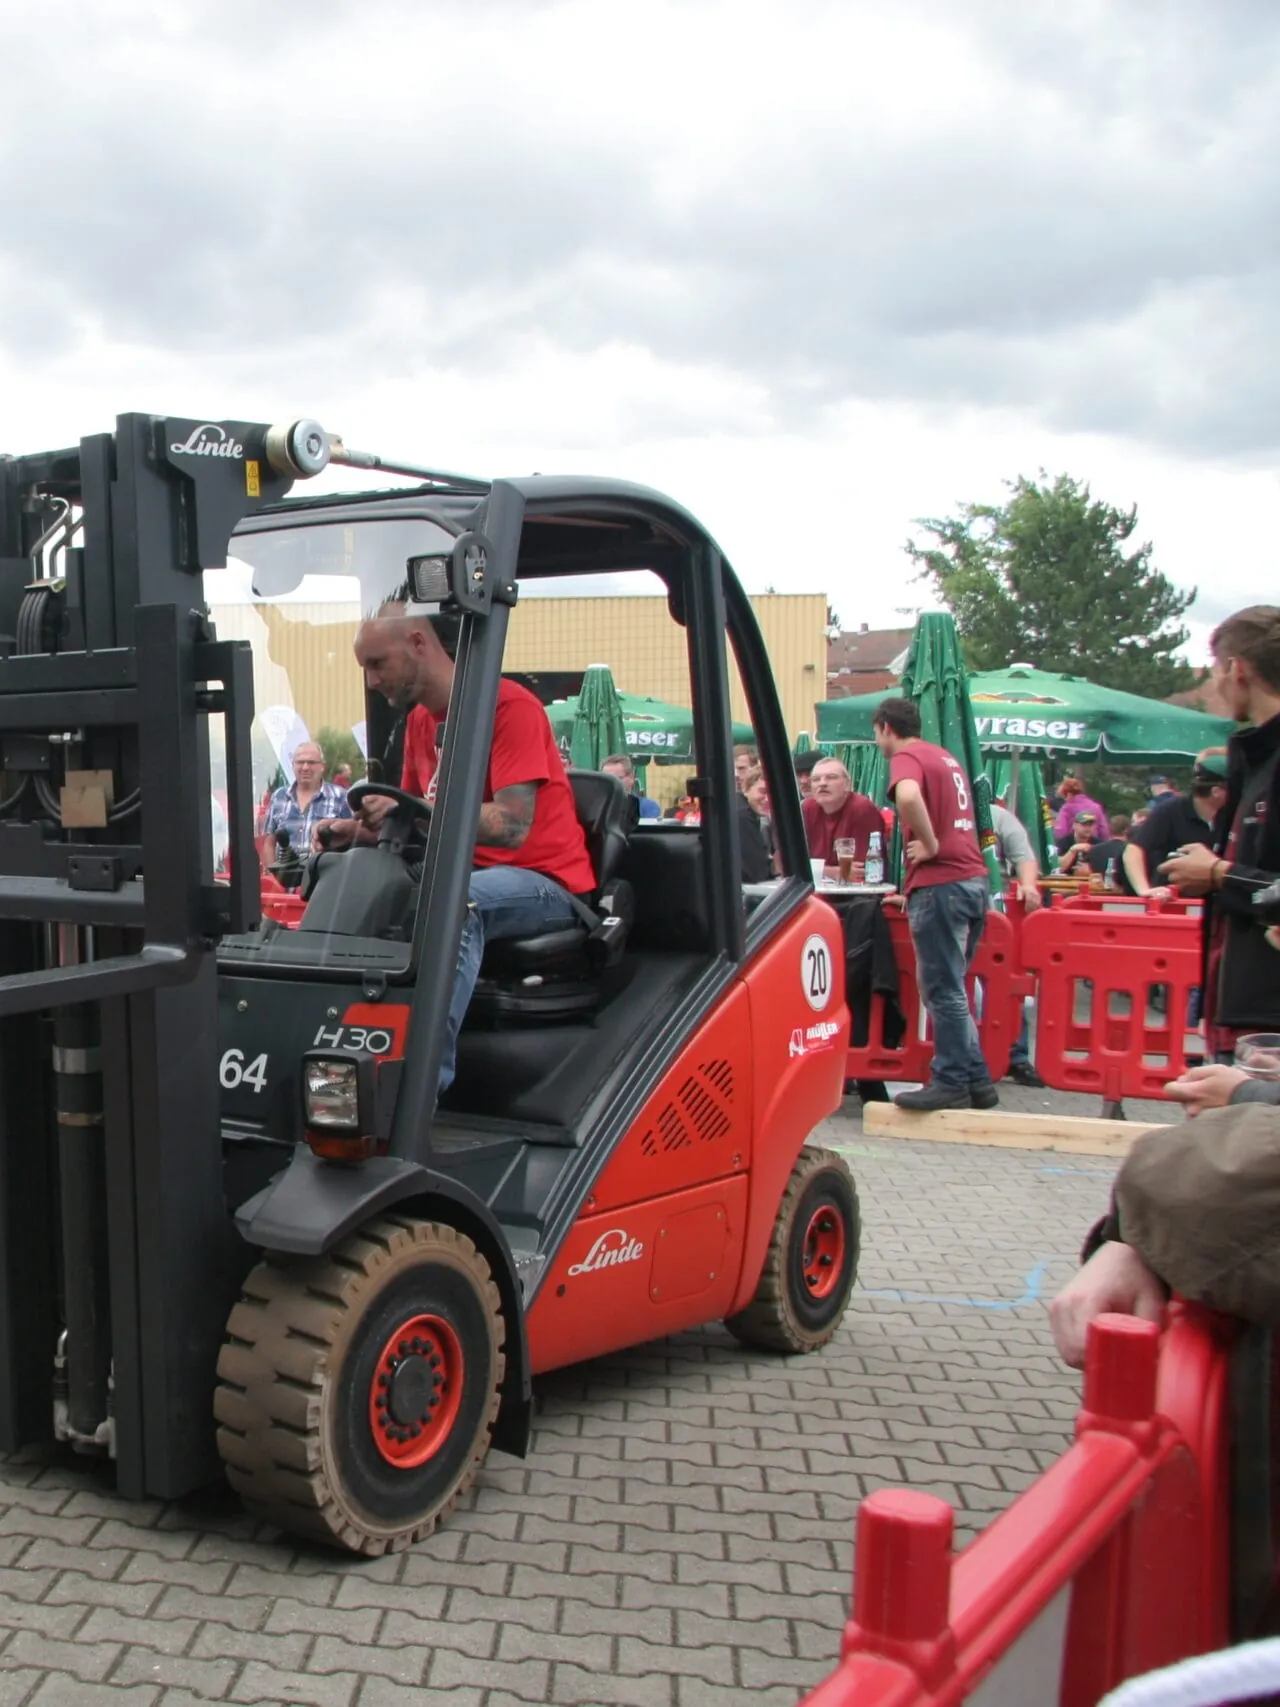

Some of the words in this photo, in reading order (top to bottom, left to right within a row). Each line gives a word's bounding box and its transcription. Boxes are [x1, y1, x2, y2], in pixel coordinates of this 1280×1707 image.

[170, 424, 243, 459] Linde
[952, 771, 968, 810] 8
[807, 948, 827, 997] 20
[313, 1025, 390, 1054] H30
[219, 1048, 269, 1094] 64
[567, 1229, 644, 1277] Linde
